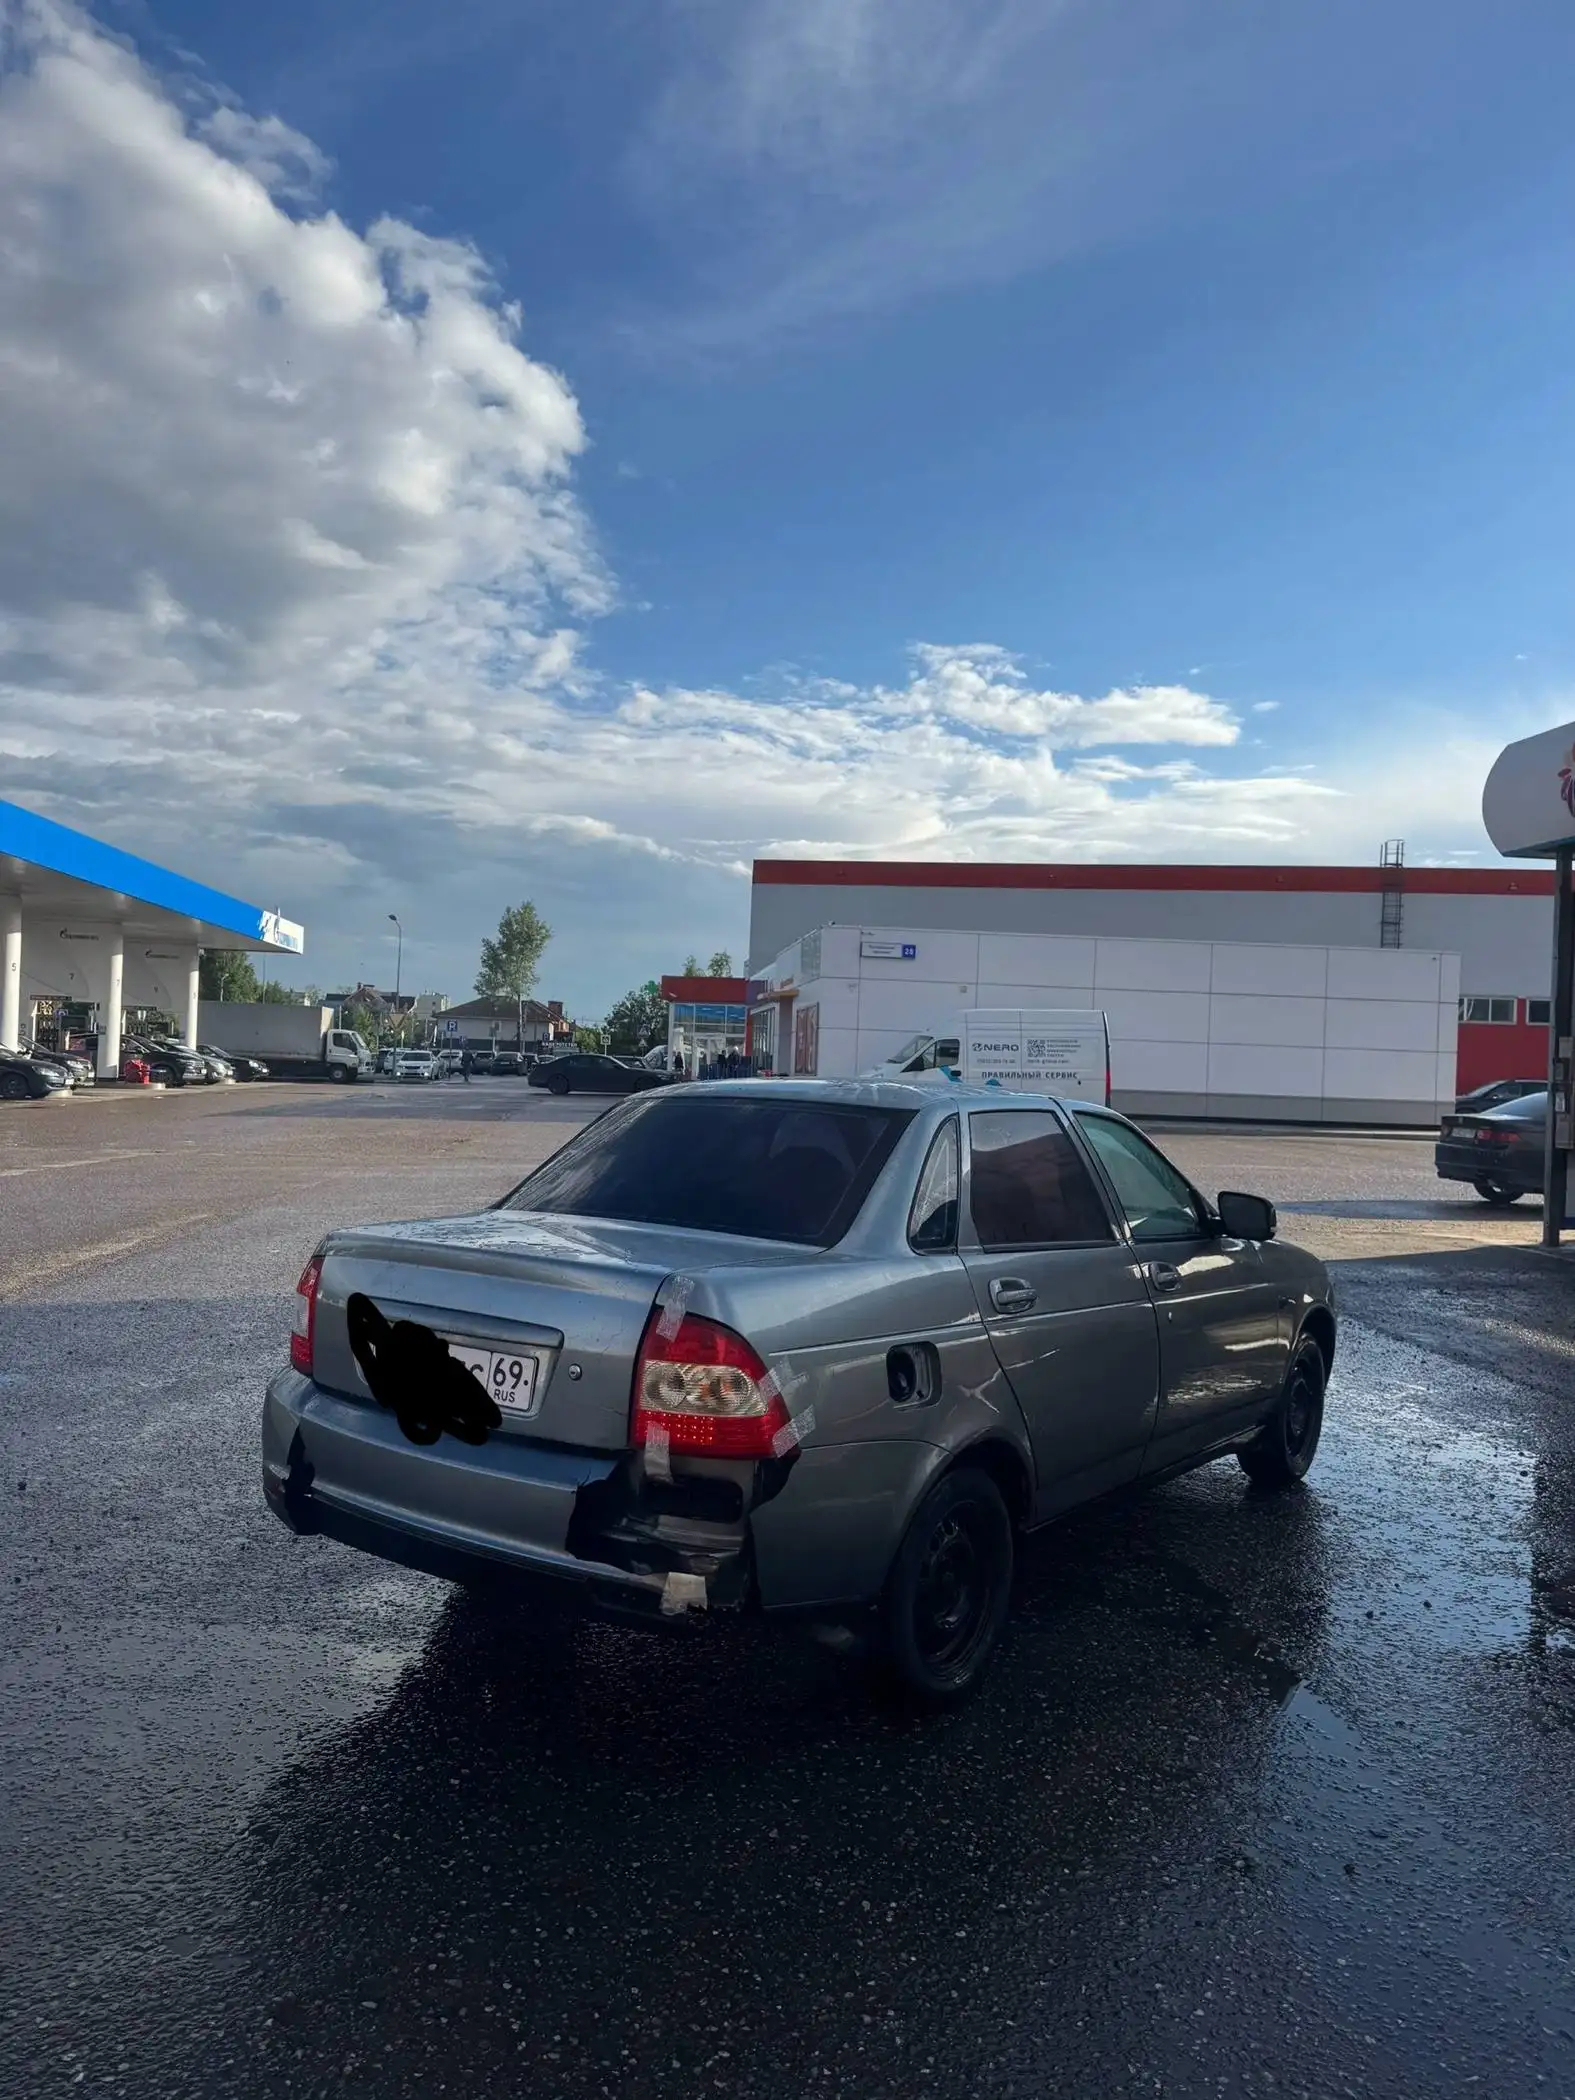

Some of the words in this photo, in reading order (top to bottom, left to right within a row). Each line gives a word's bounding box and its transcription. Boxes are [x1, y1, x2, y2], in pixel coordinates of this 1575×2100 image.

[11, 962, 17, 972] 5
[69, 972, 75, 981] 7
[983, 1043, 1020, 1052] NERO
[981, 1071, 1041, 1080] ПРАВИЛЬНЫЙ
[1045, 1072, 1078, 1080] СЕРВИС
[493, 1357, 523, 1390] 69
[493, 1388, 516, 1404] RUS
